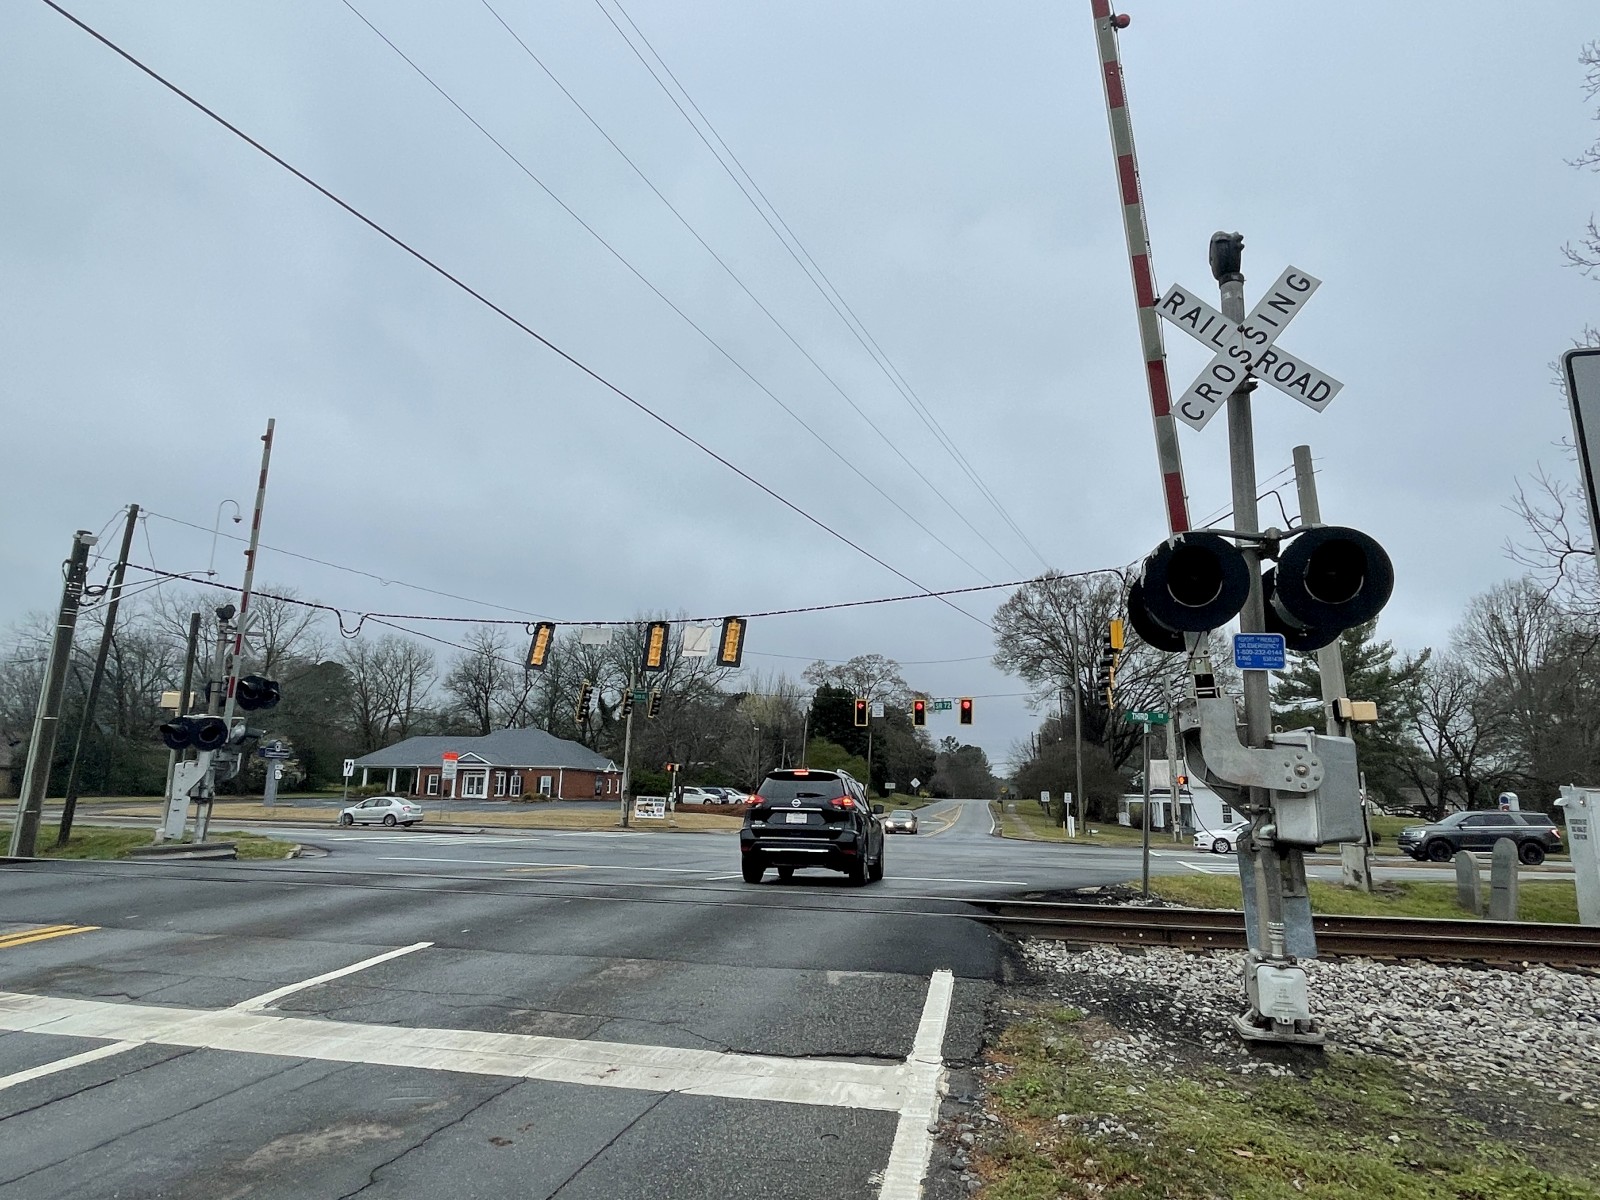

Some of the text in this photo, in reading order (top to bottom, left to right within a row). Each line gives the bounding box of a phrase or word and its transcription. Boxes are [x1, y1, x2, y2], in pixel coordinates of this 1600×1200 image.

[1162, 291, 1331, 403] RAIL ROAD
[1180, 273, 1311, 421] CROSSING
[1131, 712, 1149, 721] THIRD
